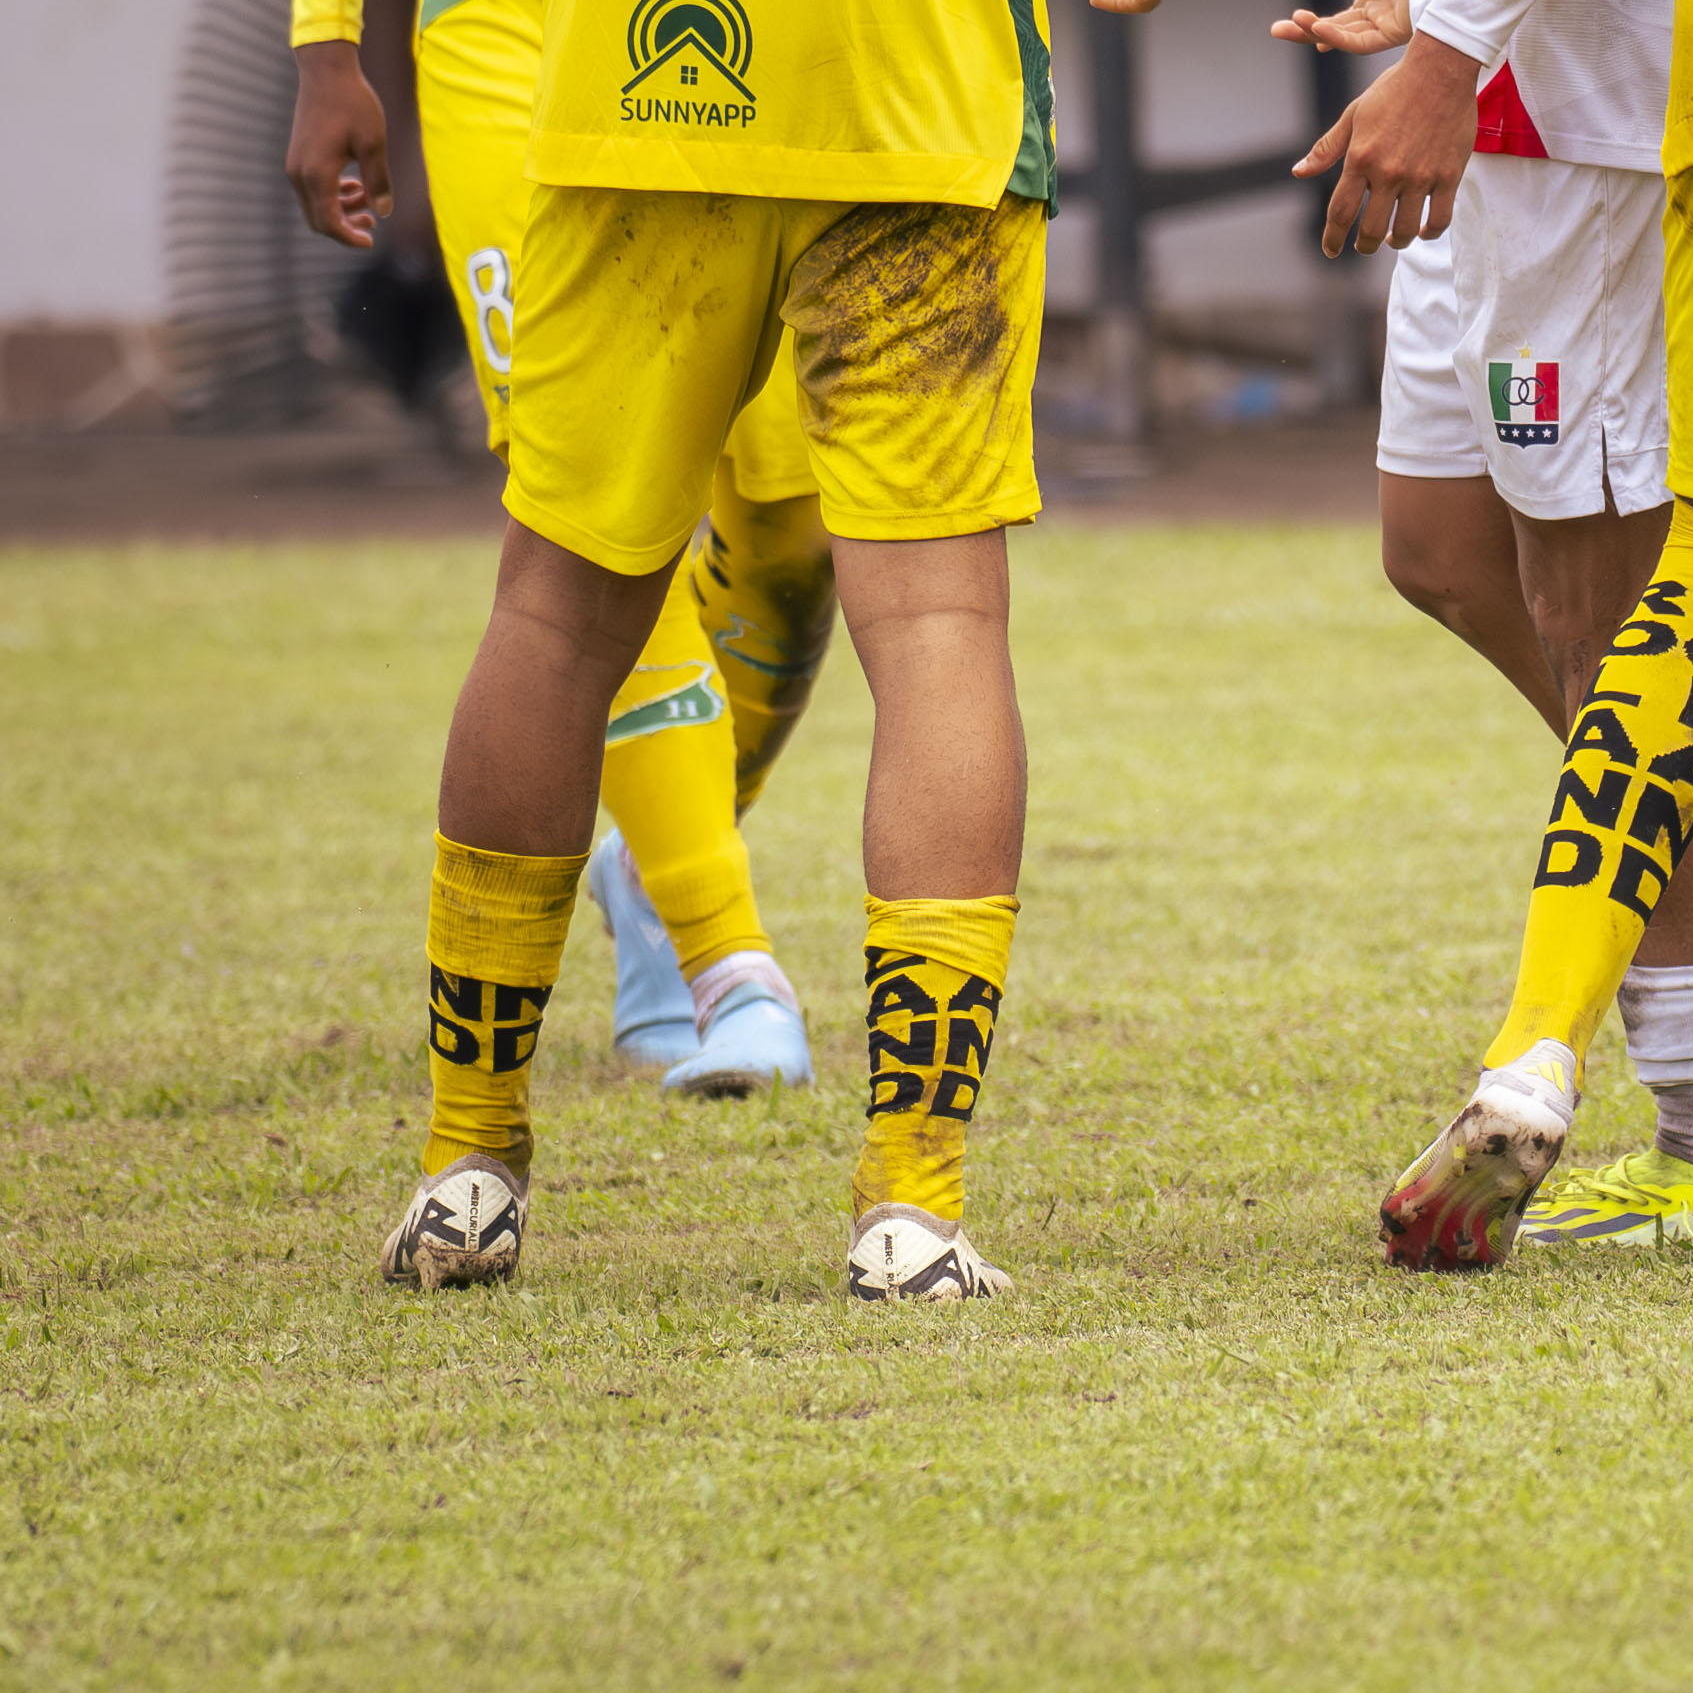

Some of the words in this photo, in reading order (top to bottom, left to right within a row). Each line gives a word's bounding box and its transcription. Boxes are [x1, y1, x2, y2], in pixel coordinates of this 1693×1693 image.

[621, 98, 756, 128] SUNNYAPP
[467, 246, 515, 376] 8
[468, 1181, 480, 1244] MERCURIAL
